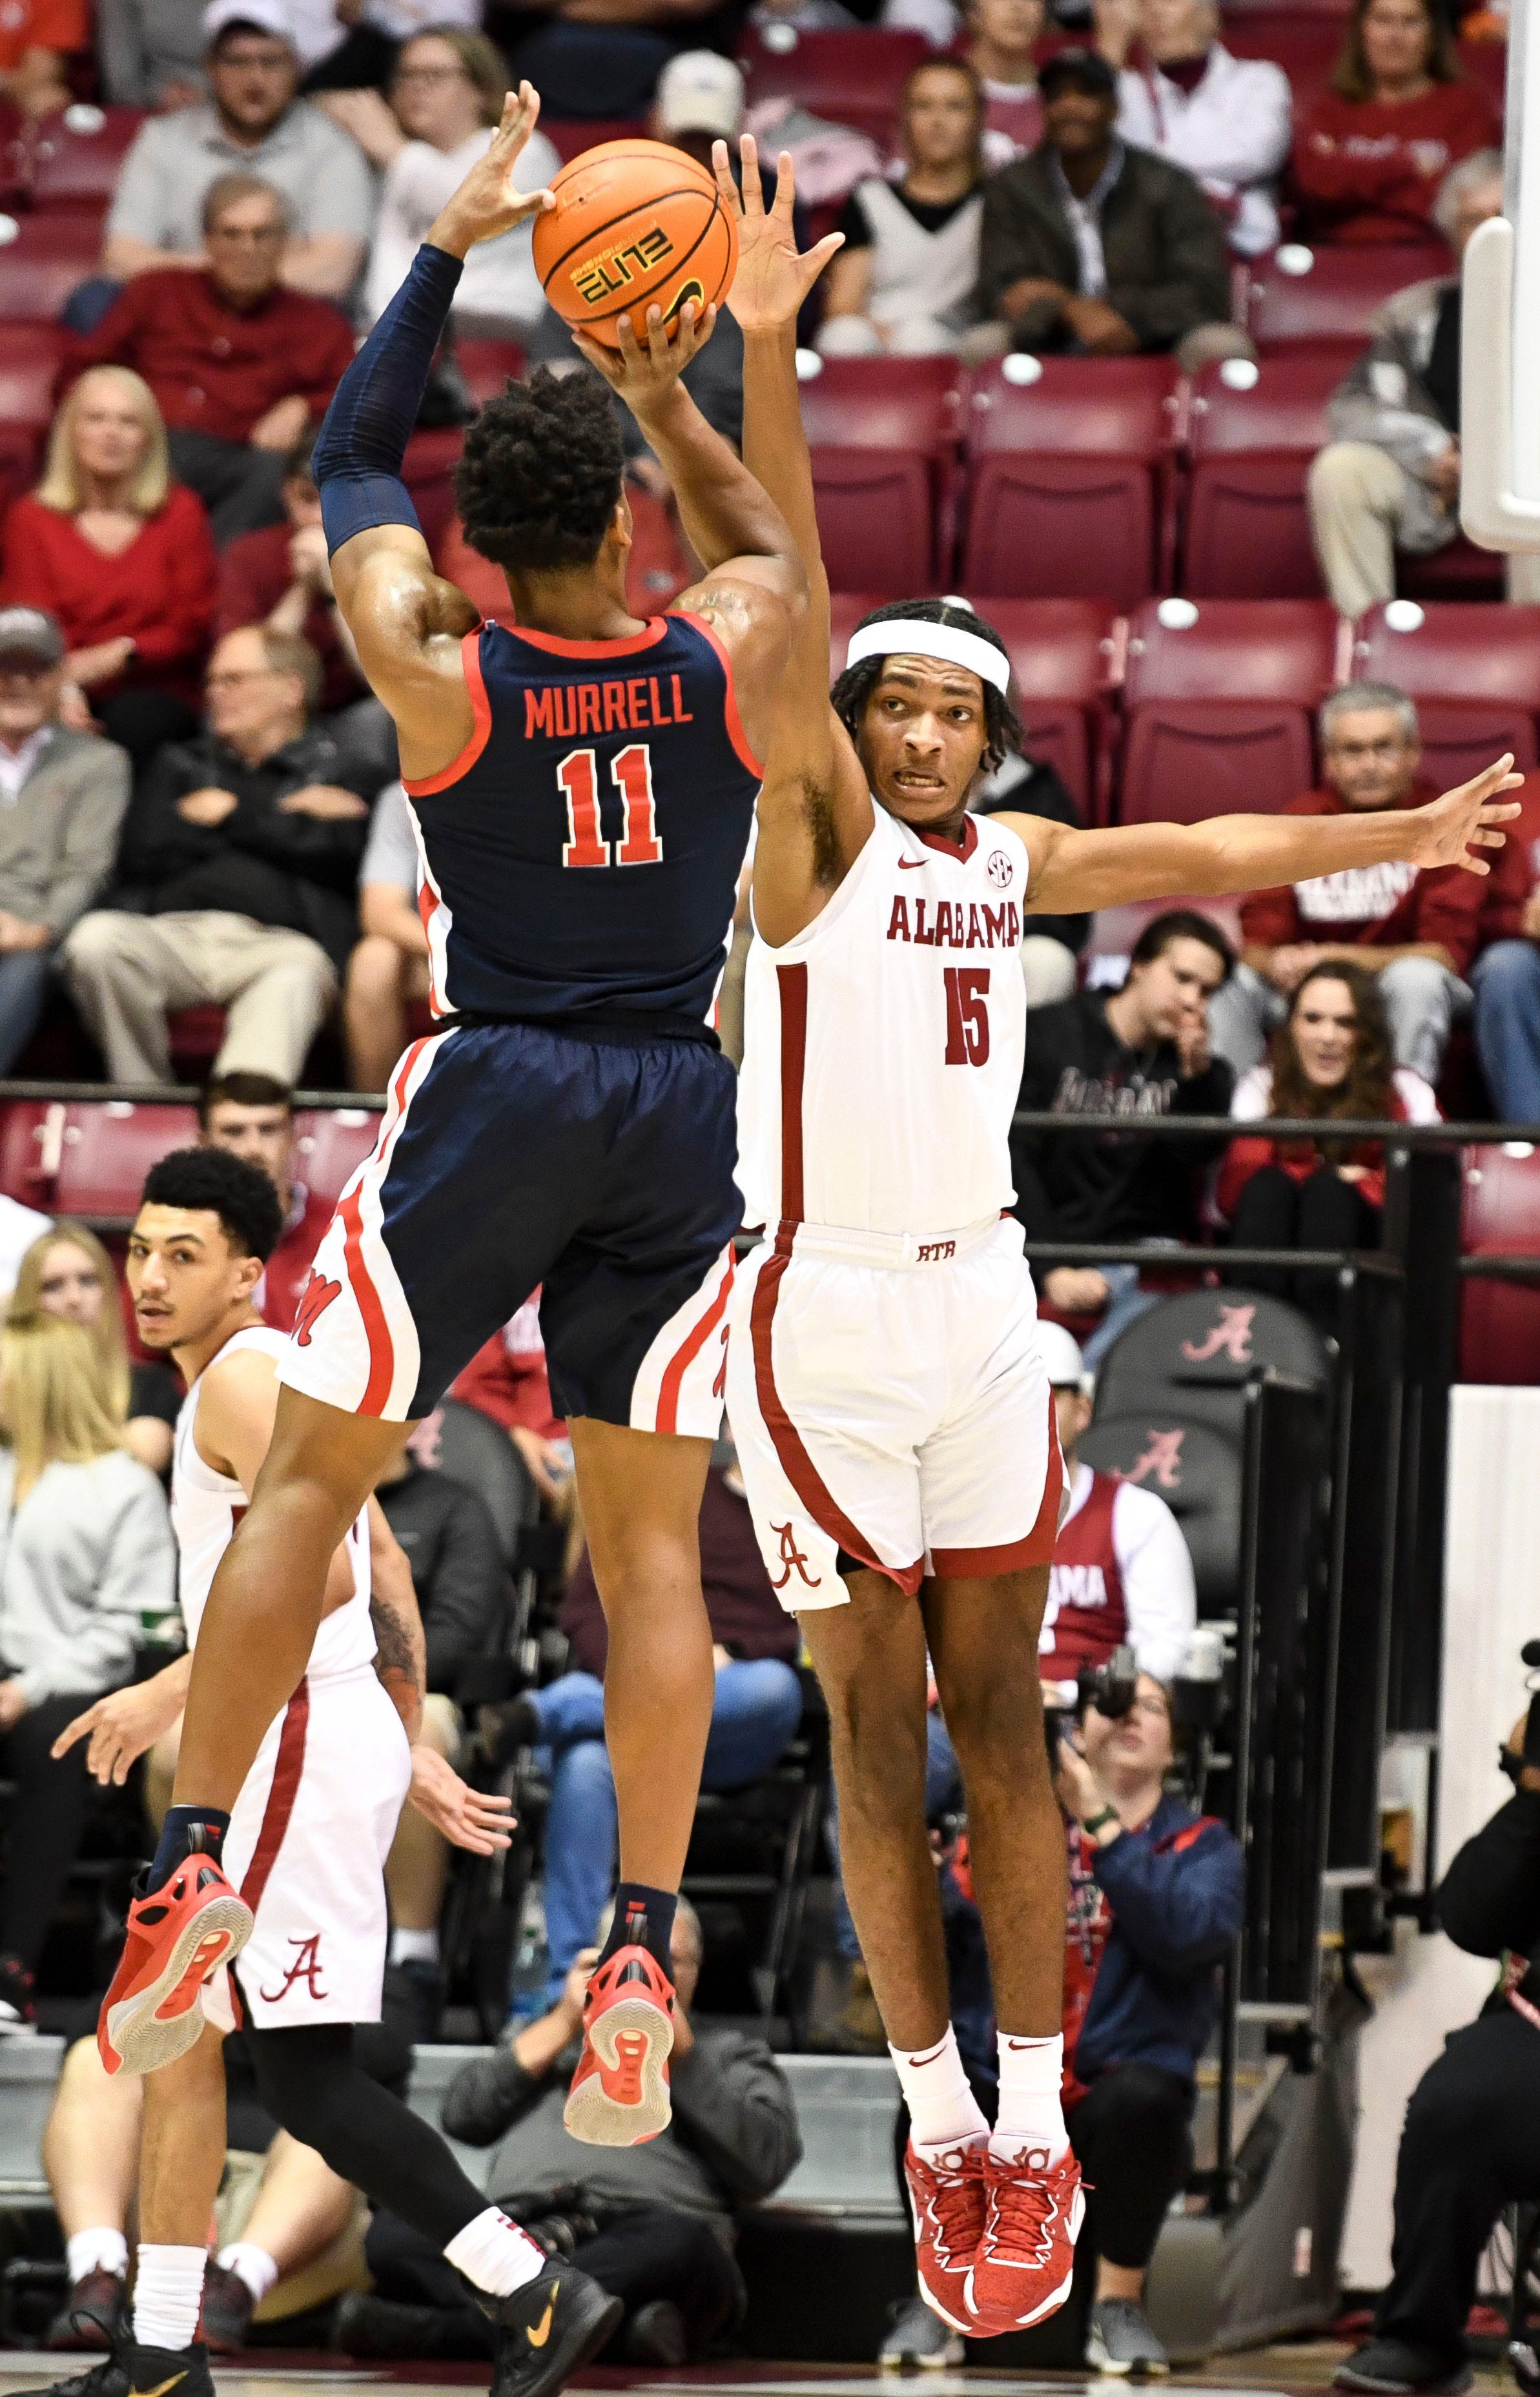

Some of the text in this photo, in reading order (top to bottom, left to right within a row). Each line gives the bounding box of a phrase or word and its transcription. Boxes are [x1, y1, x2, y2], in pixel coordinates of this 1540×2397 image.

[575, 226, 674, 306] ELITE
[524, 674, 693, 739] MURRELL
[557, 744, 663, 868] 11
[988, 851, 1012, 887] SEC
[887, 895, 1020, 949] ALABAMA
[943, 967, 991, 1067] 15
[915, 1240, 956, 1262] RTR
[260, 1933, 329, 2002] A
